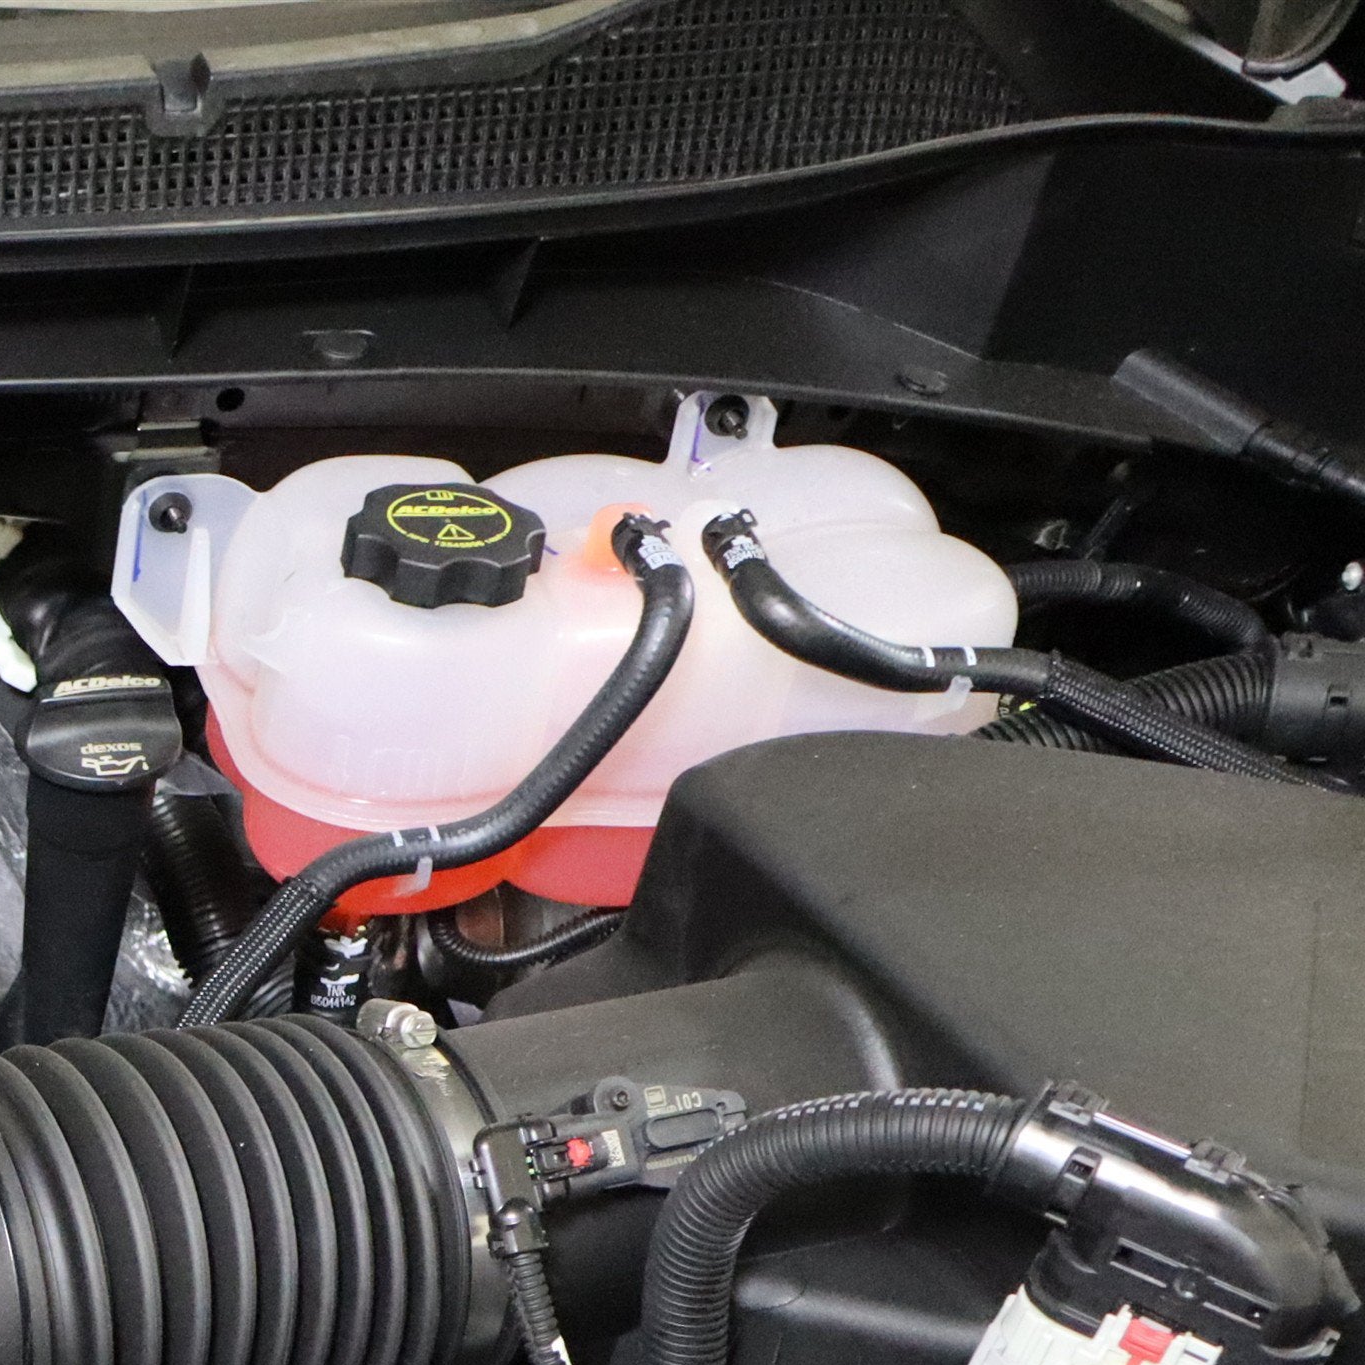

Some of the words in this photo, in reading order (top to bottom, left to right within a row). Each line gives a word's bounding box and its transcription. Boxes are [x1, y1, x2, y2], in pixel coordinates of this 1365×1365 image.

[394, 505, 498, 516] ACDelco
[53, 675, 161, 697] ACDelco
[80, 742, 143, 755] dexos
